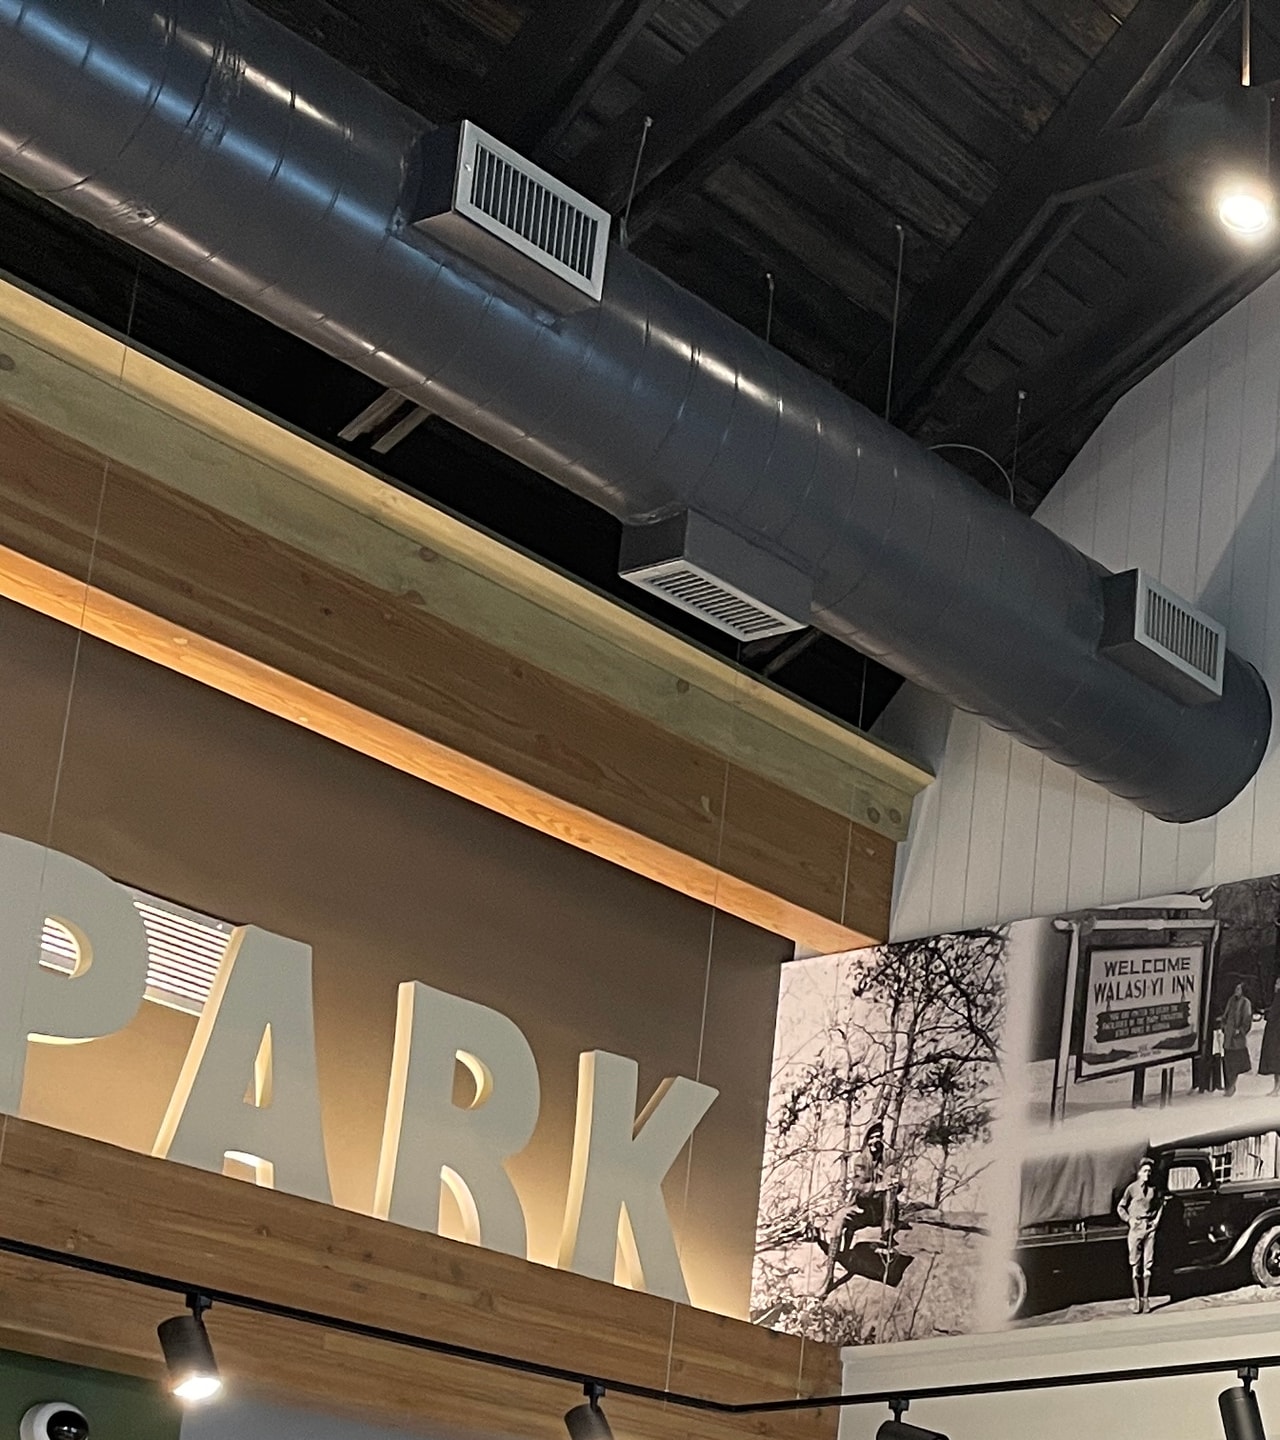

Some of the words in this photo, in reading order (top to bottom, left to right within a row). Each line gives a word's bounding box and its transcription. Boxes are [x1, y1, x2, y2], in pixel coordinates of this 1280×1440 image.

[1104, 957, 1191, 977] WELCOME
[1172, 974, 1195, 995] INN
[0, 833, 719, 1307] PARK
